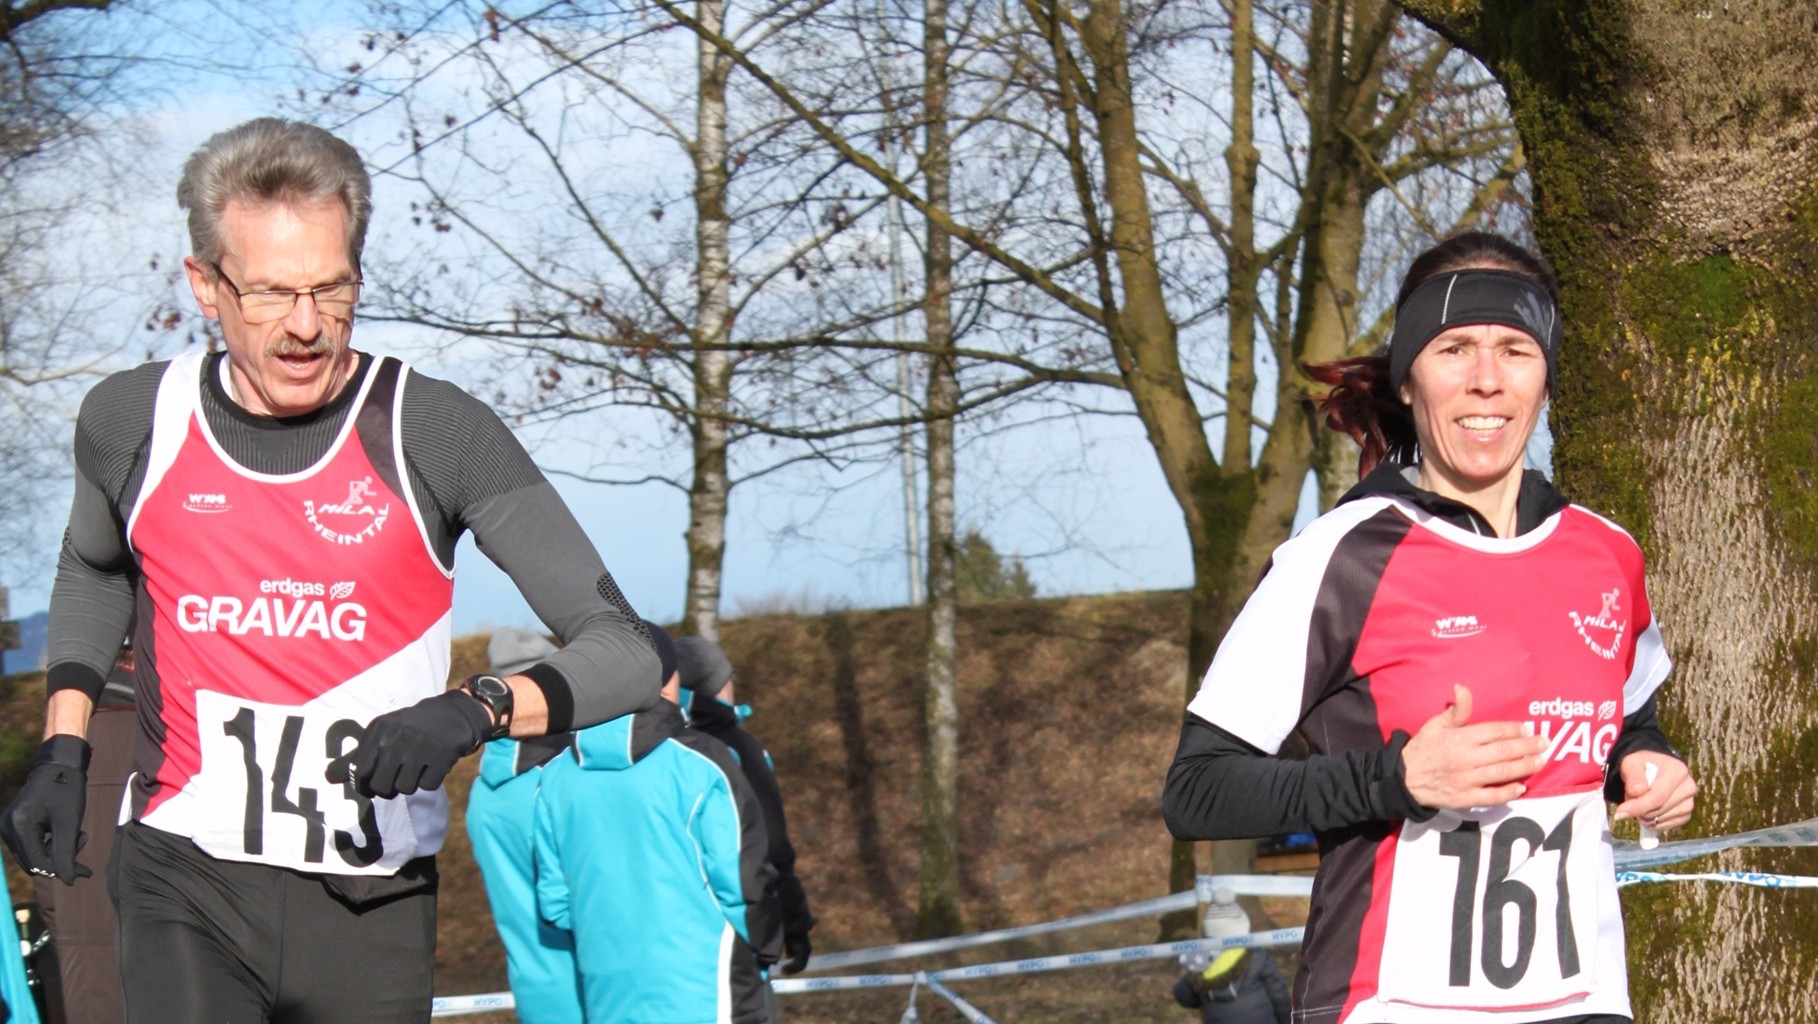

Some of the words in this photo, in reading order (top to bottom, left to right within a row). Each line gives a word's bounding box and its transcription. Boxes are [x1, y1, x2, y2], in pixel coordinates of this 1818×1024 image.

[303, 500, 389, 545] RHEINTAL
[318, 503, 375, 515] MILA
[260, 577, 325, 597] erdgas
[177, 594, 367, 641] GRAVAG
[1583, 614, 1617, 631] MILA
[1528, 697, 1594, 719] erdgas
[223, 706, 384, 868] 143
[1438, 806, 1581, 990] 161
